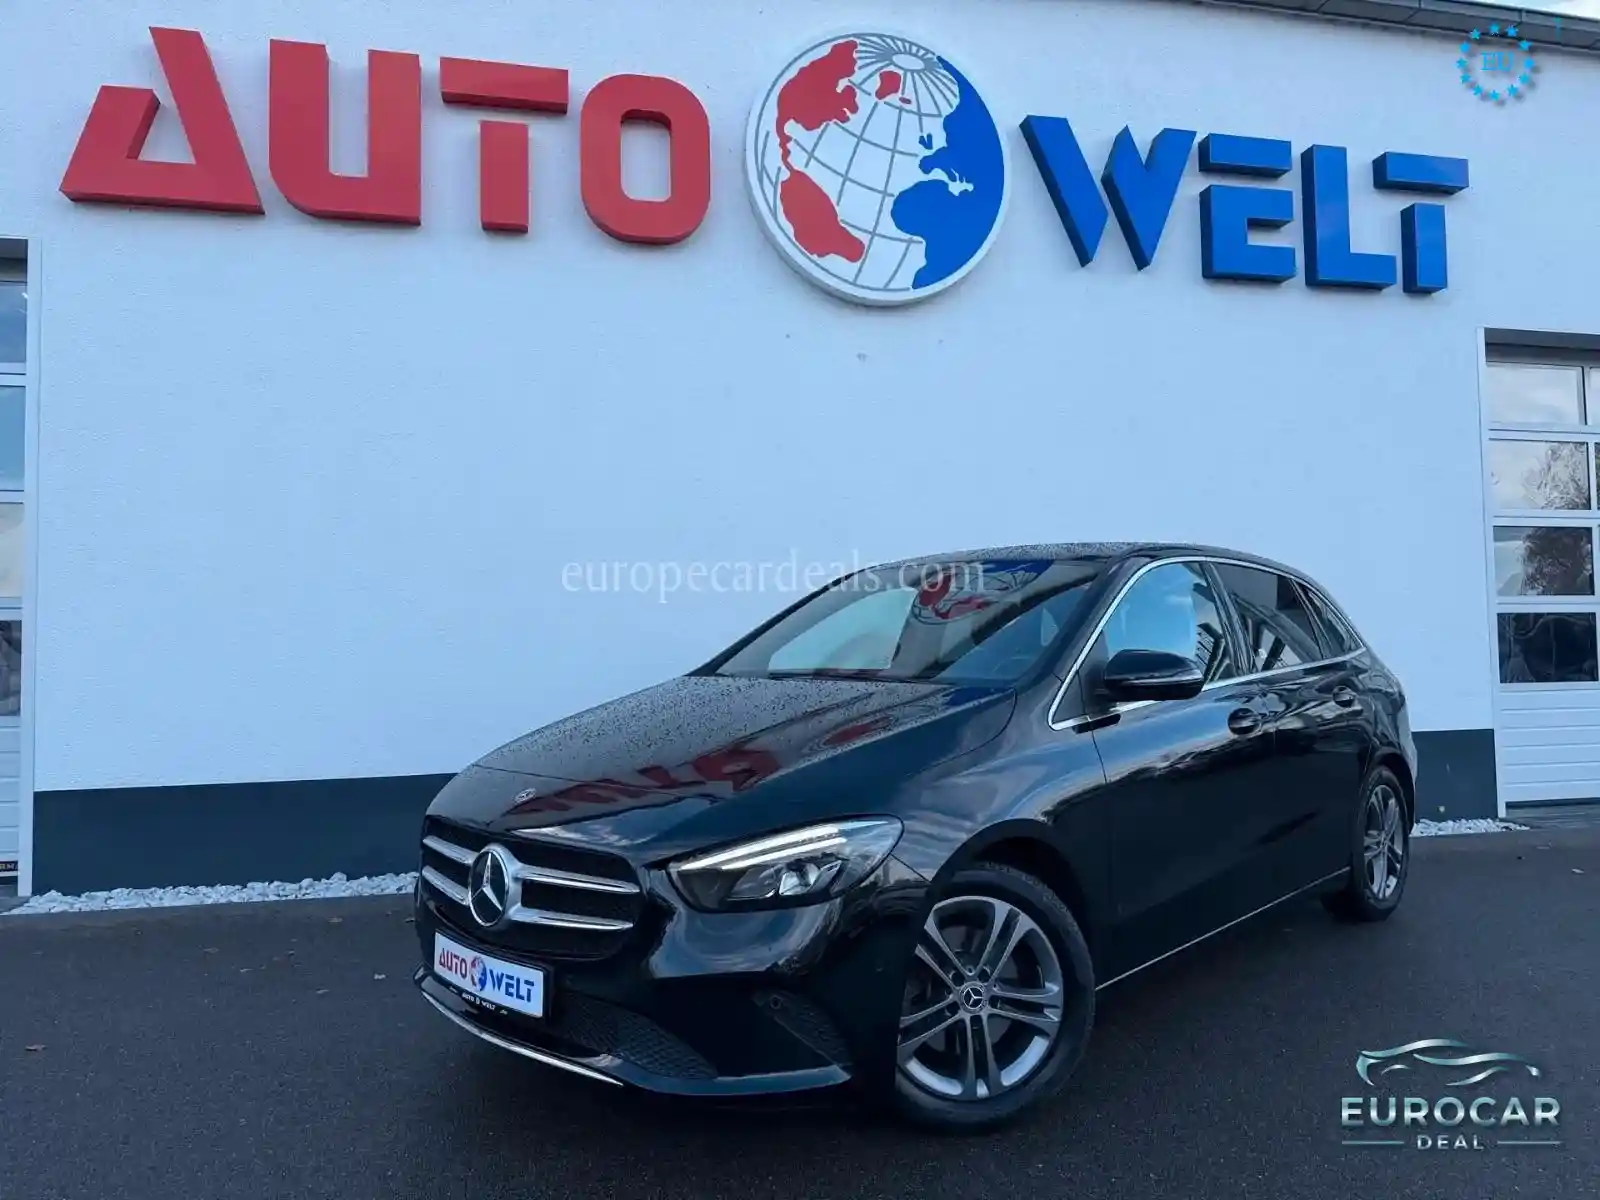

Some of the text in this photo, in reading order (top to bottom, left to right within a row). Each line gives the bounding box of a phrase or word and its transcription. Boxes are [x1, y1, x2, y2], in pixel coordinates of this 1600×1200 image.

[59, 26, 1470, 295] AUTO WELT
[439, 948, 535, 1002] AUTO WELT
